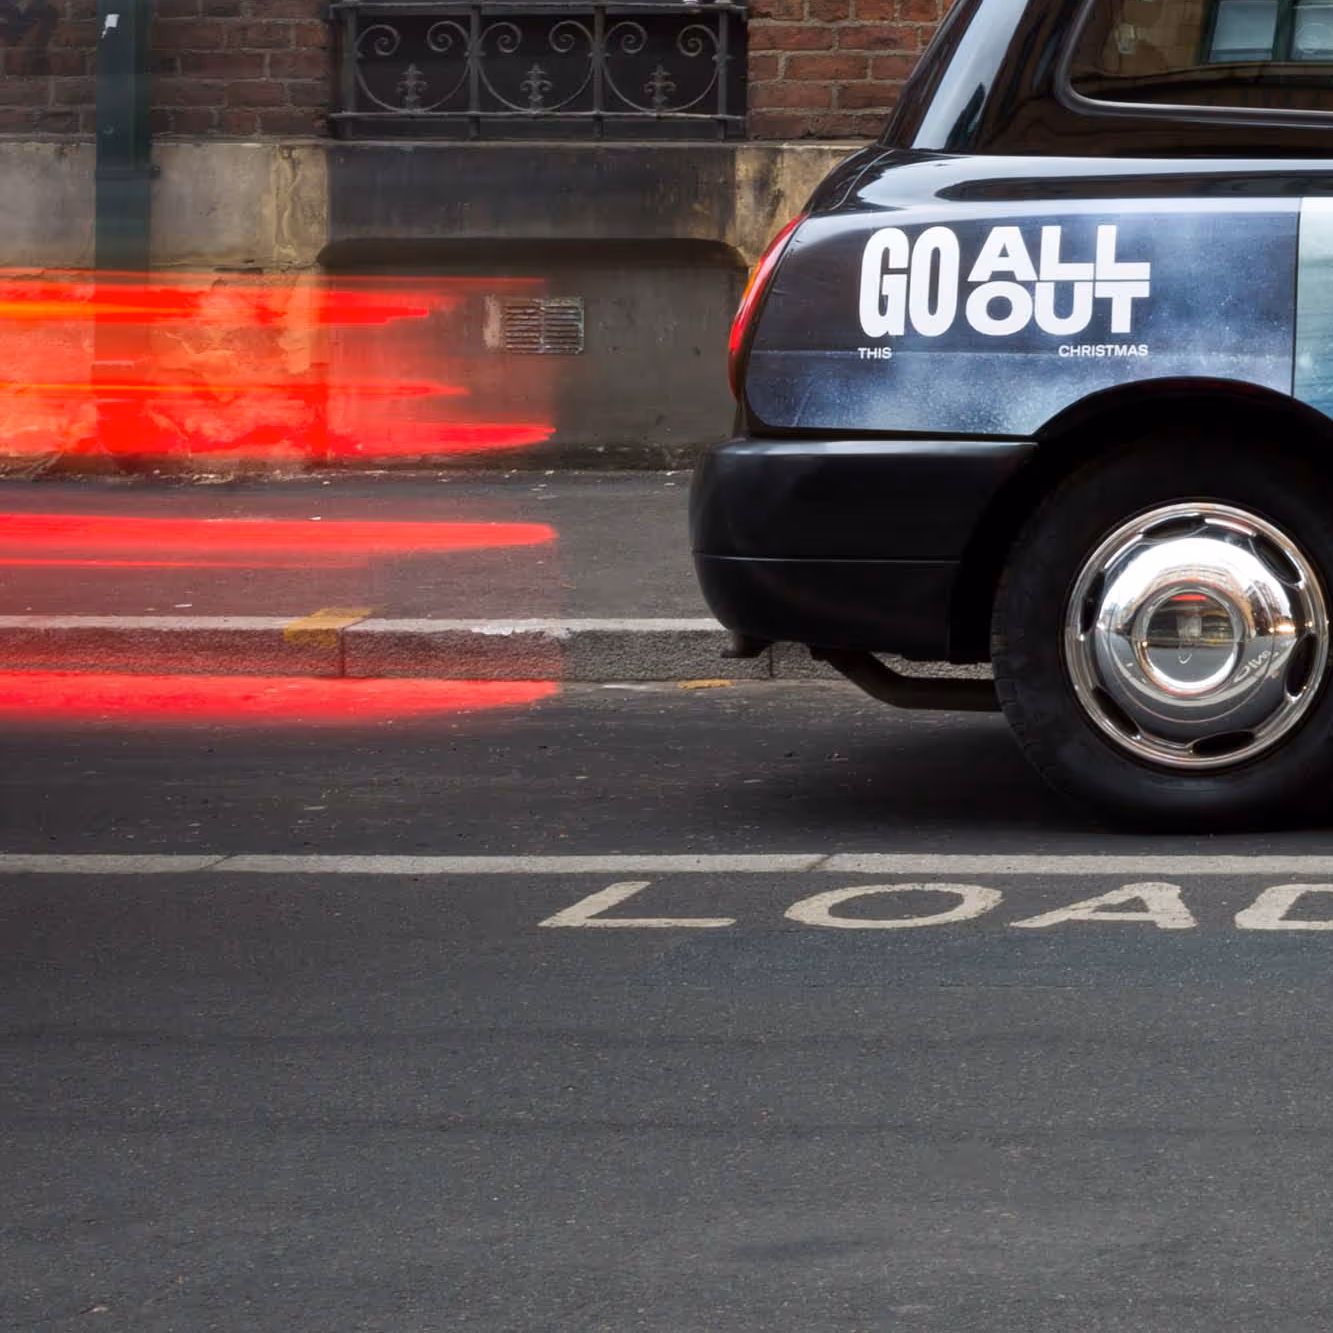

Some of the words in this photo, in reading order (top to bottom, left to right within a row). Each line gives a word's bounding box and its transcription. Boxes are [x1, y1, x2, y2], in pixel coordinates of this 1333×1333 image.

[859, 225, 960, 338] GO
[967, 224, 1151, 282] ALL
[965, 280, 1150, 337] OUT
[857, 346, 893, 360] THIS
[1058, 343, 1149, 358] CHRISTMAS
